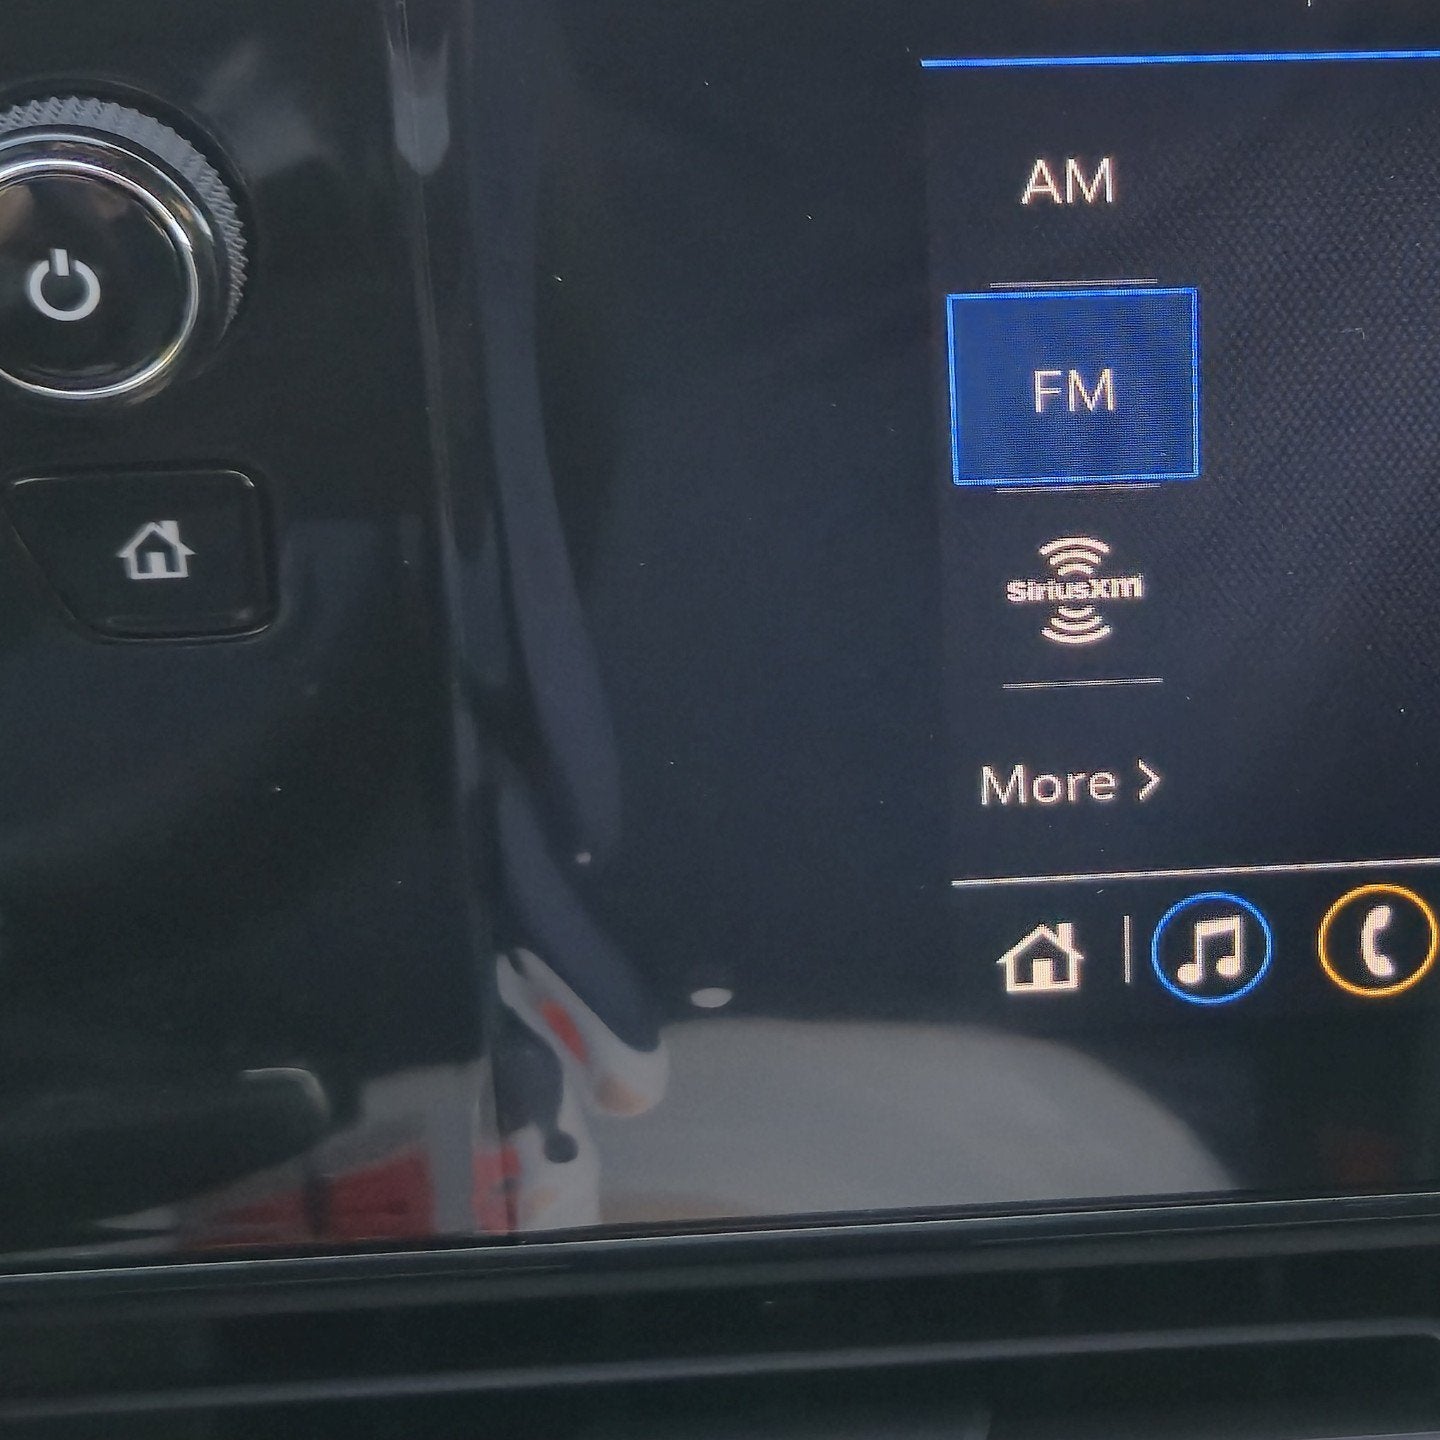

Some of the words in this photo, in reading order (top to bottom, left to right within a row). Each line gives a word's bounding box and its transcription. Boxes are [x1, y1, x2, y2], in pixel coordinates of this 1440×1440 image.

[1020, 156, 1115, 206] AM
[1033, 367, 1116, 415] FM
[979, 763, 1119, 807] More
